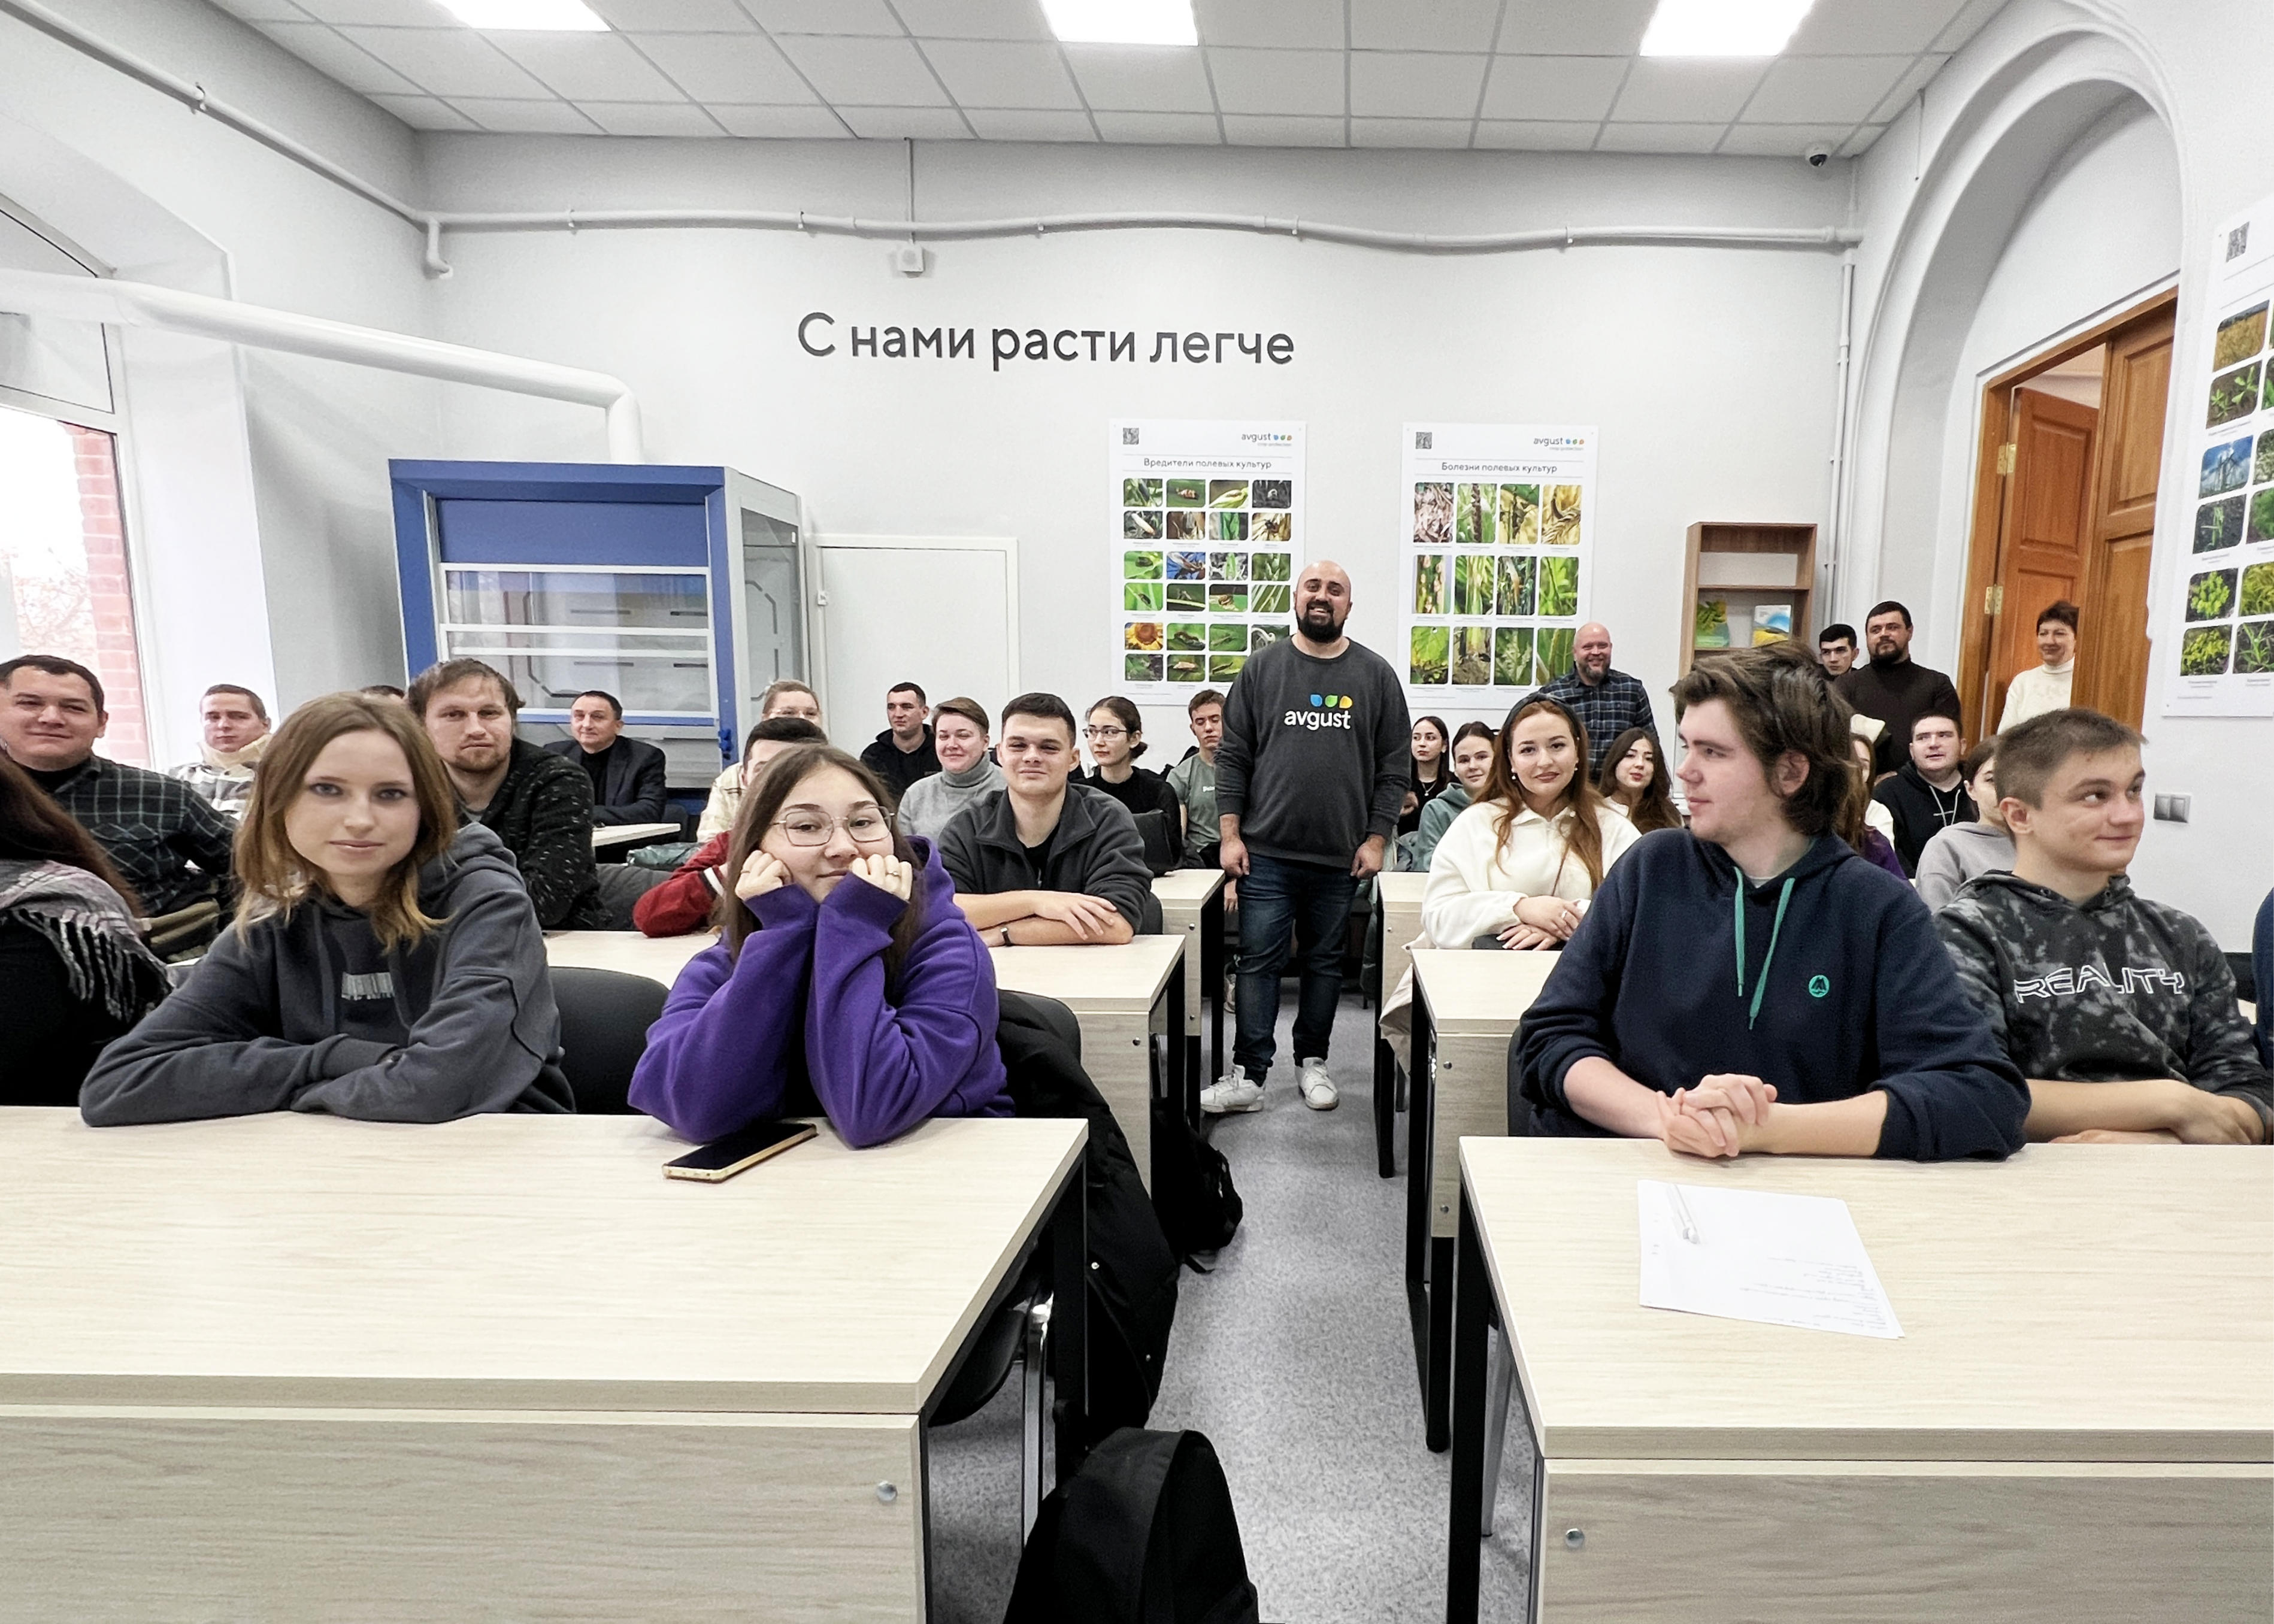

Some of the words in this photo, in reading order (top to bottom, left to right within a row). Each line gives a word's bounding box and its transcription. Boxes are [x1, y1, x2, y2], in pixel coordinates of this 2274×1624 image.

[798, 312, 835, 357] С
[851, 326, 974, 359] нами
[992, 328, 1135, 372] расти
[1149, 332, 1294, 365] легче
[1242, 432, 1271, 443] avgust
[1533, 437, 1563, 446] avgust
[1144, 457, 1193, 468] Вредители
[1236, 461, 1271, 469] культур
[1442, 462, 1479, 471] Болезни
[1522, 465, 1557, 474] культур
[1284, 710, 1351, 731] avgust
[2013, 962, 2185, 1004] REALITY
